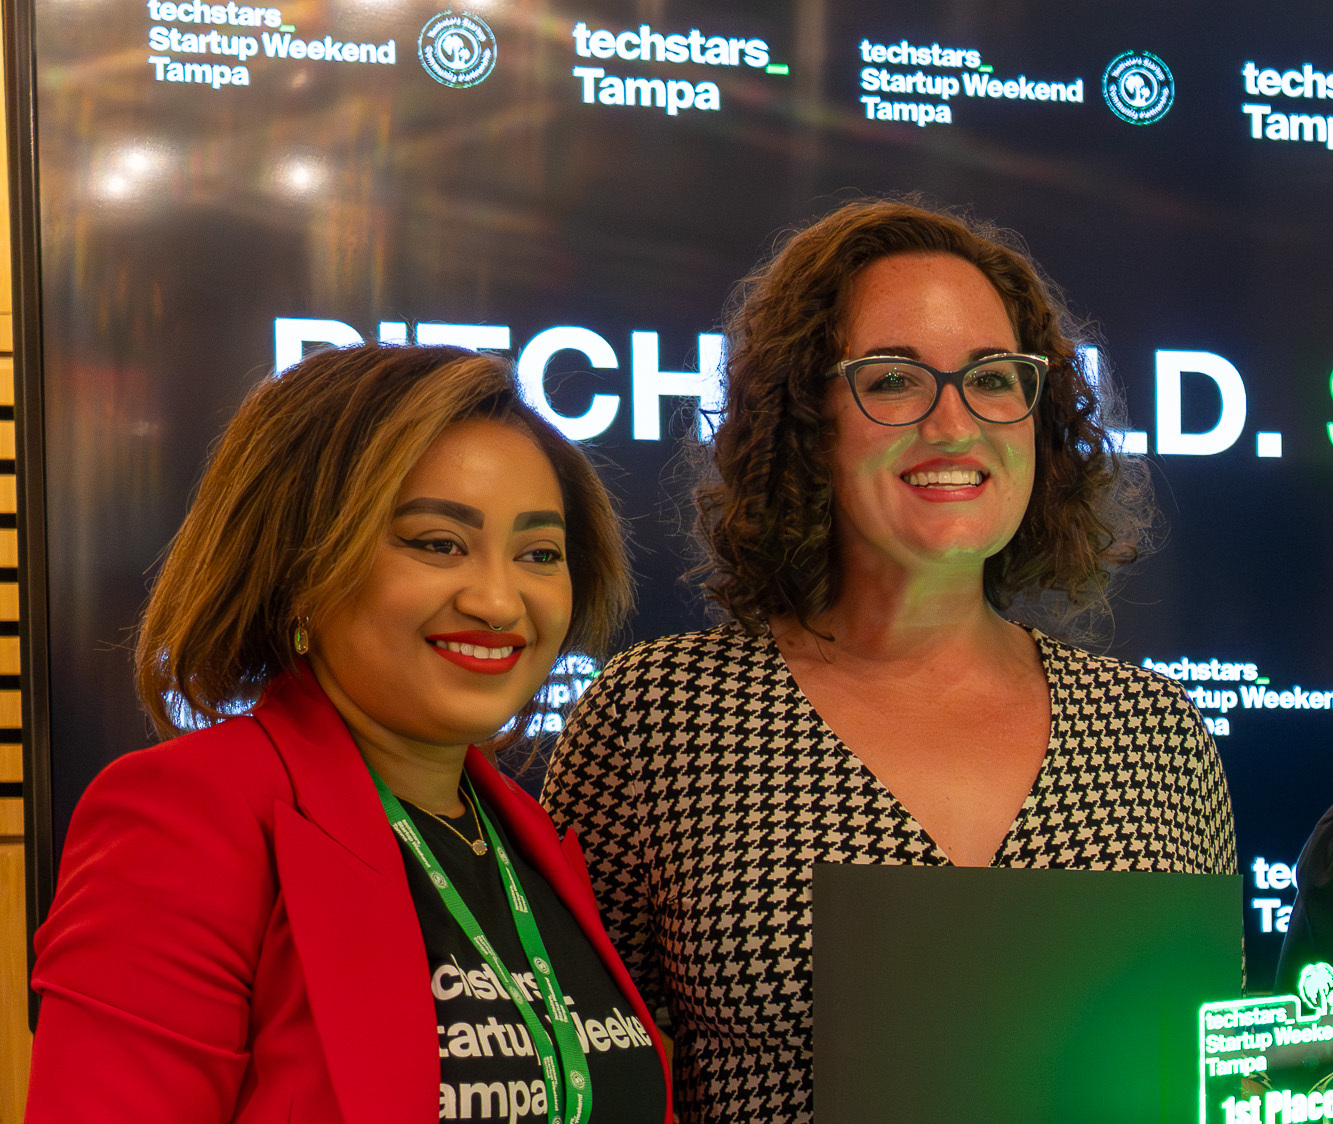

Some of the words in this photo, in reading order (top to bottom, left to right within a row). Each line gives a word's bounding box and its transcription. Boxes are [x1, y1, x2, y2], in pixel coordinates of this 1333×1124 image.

[148, 25, 259, 61] Startup
[261, 32, 396, 65] Weekend
[148, 55, 250, 89] Tampa
[860, 66, 960, 100] Startup
[961, 71, 1084, 103] Weekend
[572, 65, 721, 116] Tampa
[860, 95, 952, 127] Tampa
[1206, 1031, 1273, 1054] Startup
[1206, 1055, 1268, 1077] Tampa
